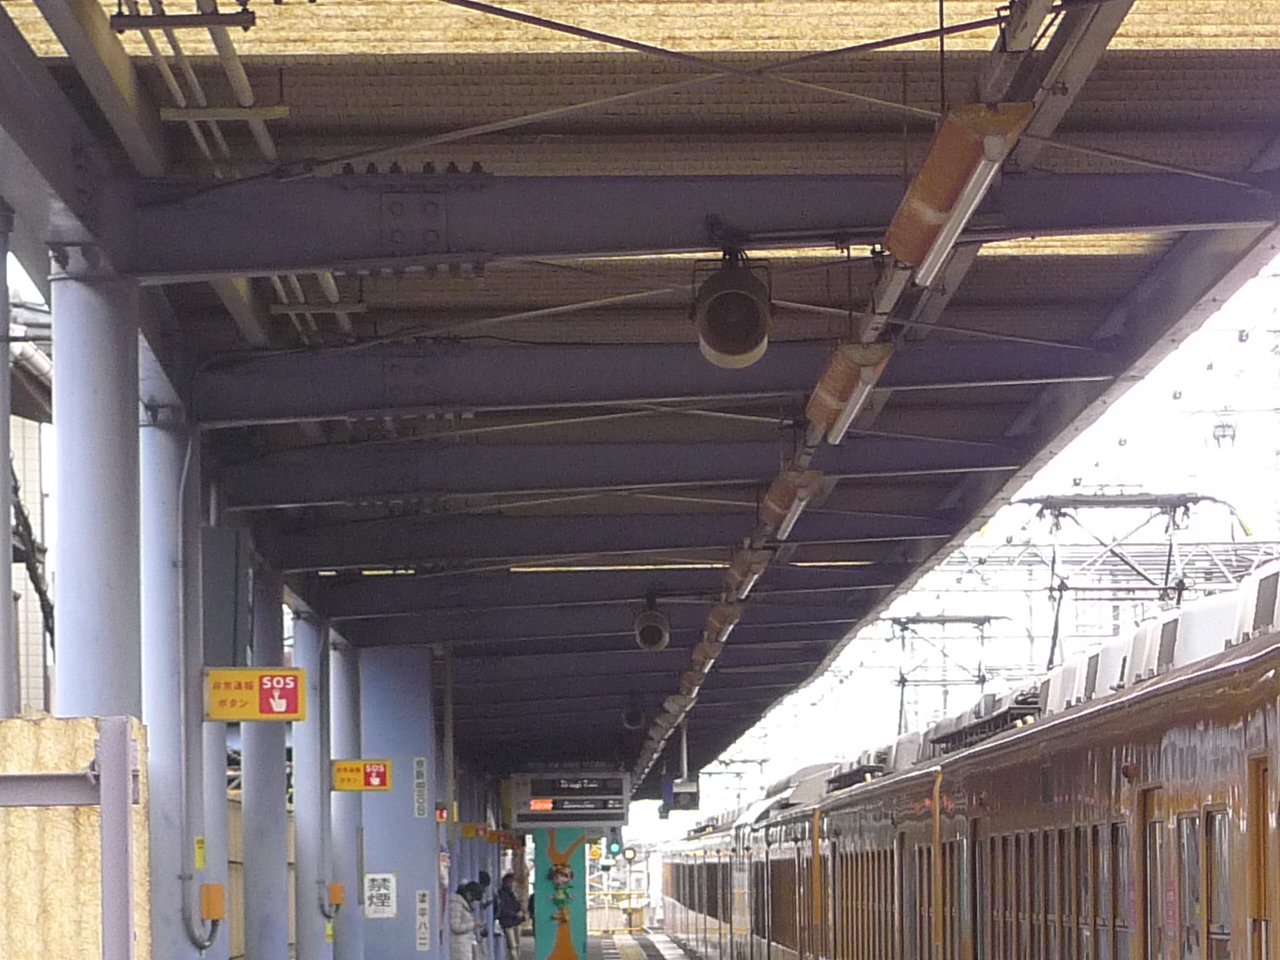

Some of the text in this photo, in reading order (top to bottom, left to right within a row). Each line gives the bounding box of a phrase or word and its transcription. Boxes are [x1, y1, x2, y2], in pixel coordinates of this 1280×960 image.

[212, 681, 255, 691] 非常通報
[262, 676, 295, 689] SOS
[217, 699, 249, 709] ボタン
[365, 764, 385, 772] SOS
[367, 877, 391, 907] 禁煙
